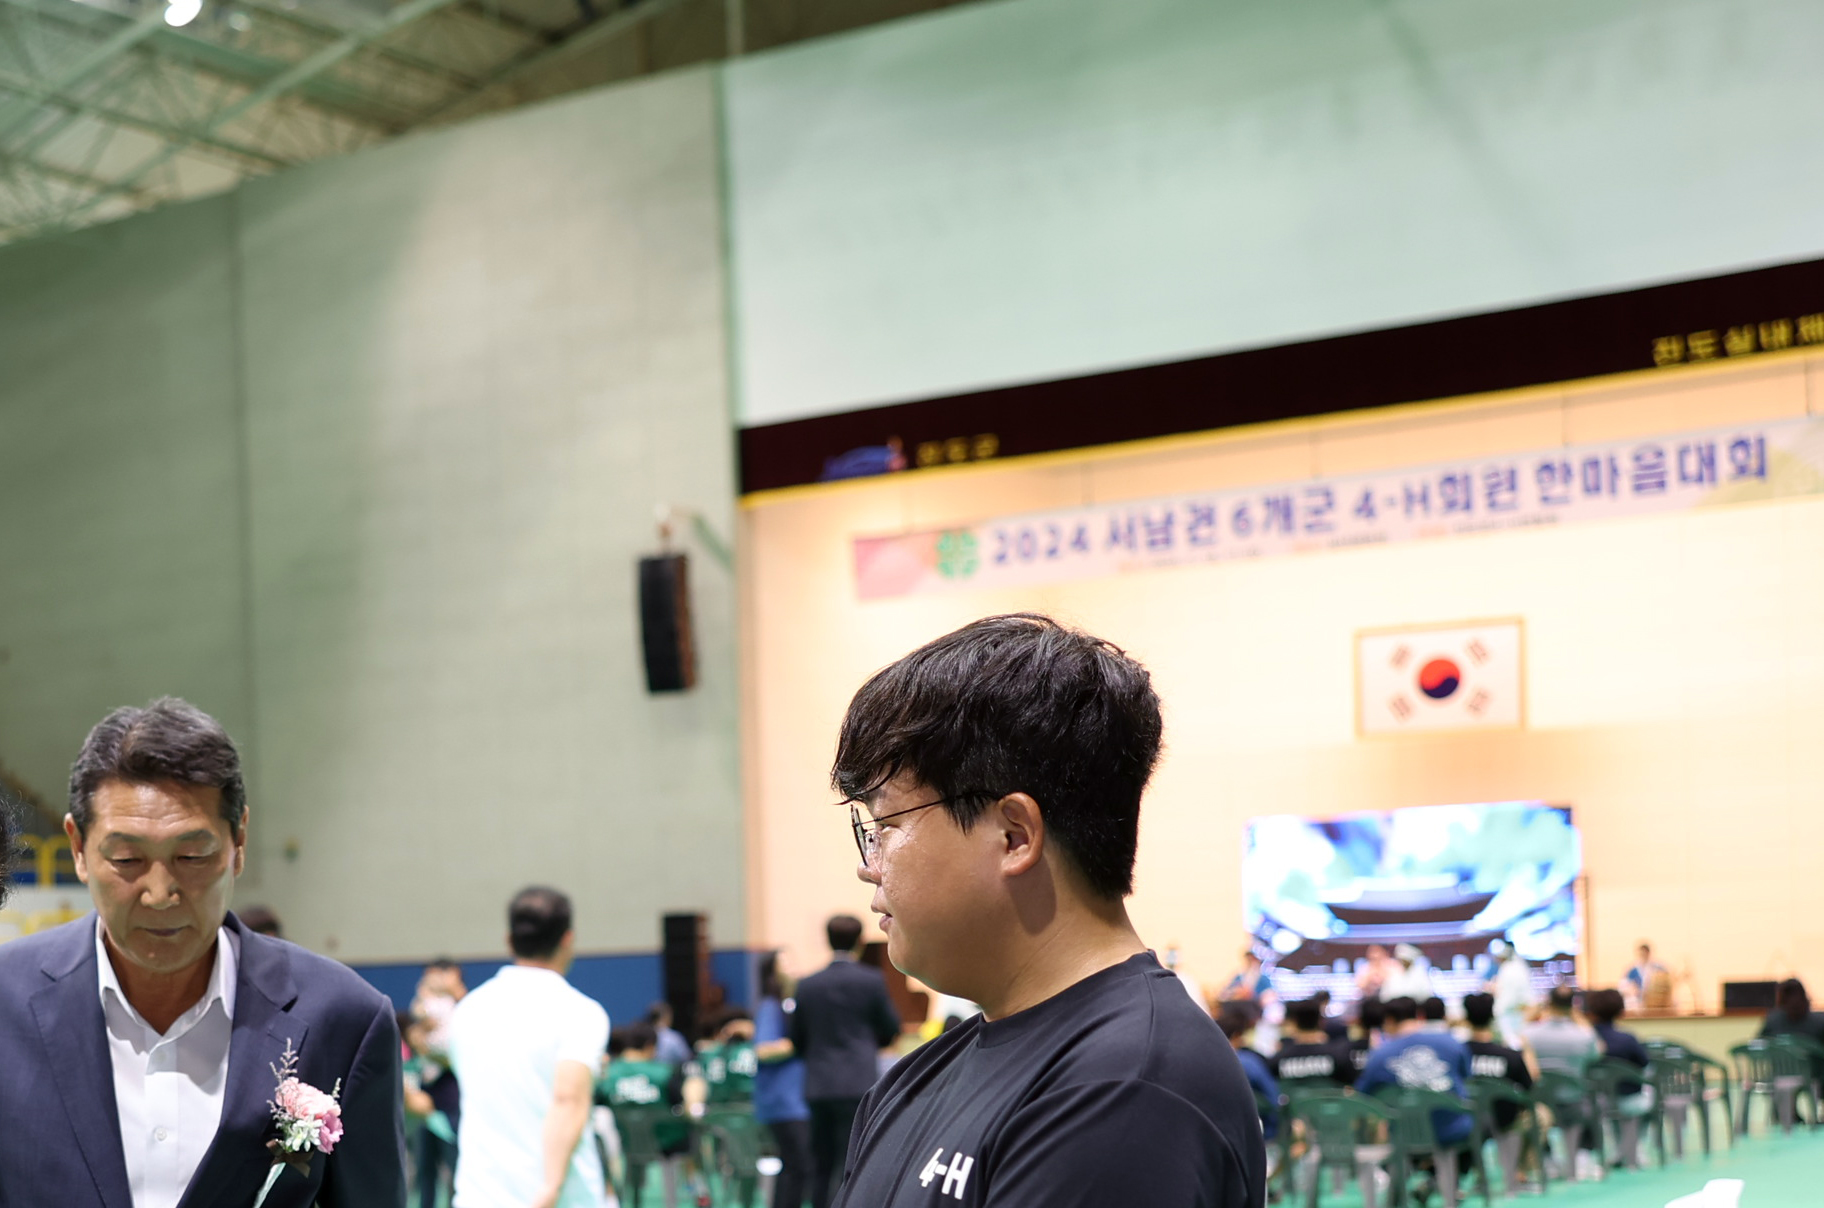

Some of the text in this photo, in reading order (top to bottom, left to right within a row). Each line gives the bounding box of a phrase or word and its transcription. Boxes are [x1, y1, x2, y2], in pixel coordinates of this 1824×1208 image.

[993, 523, 1090, 565] 2024
[1231, 487, 1335, 537] 6개군
[1535, 433, 1770, 505] 한마음대회
[919, 1147, 974, 1200] 4-H
